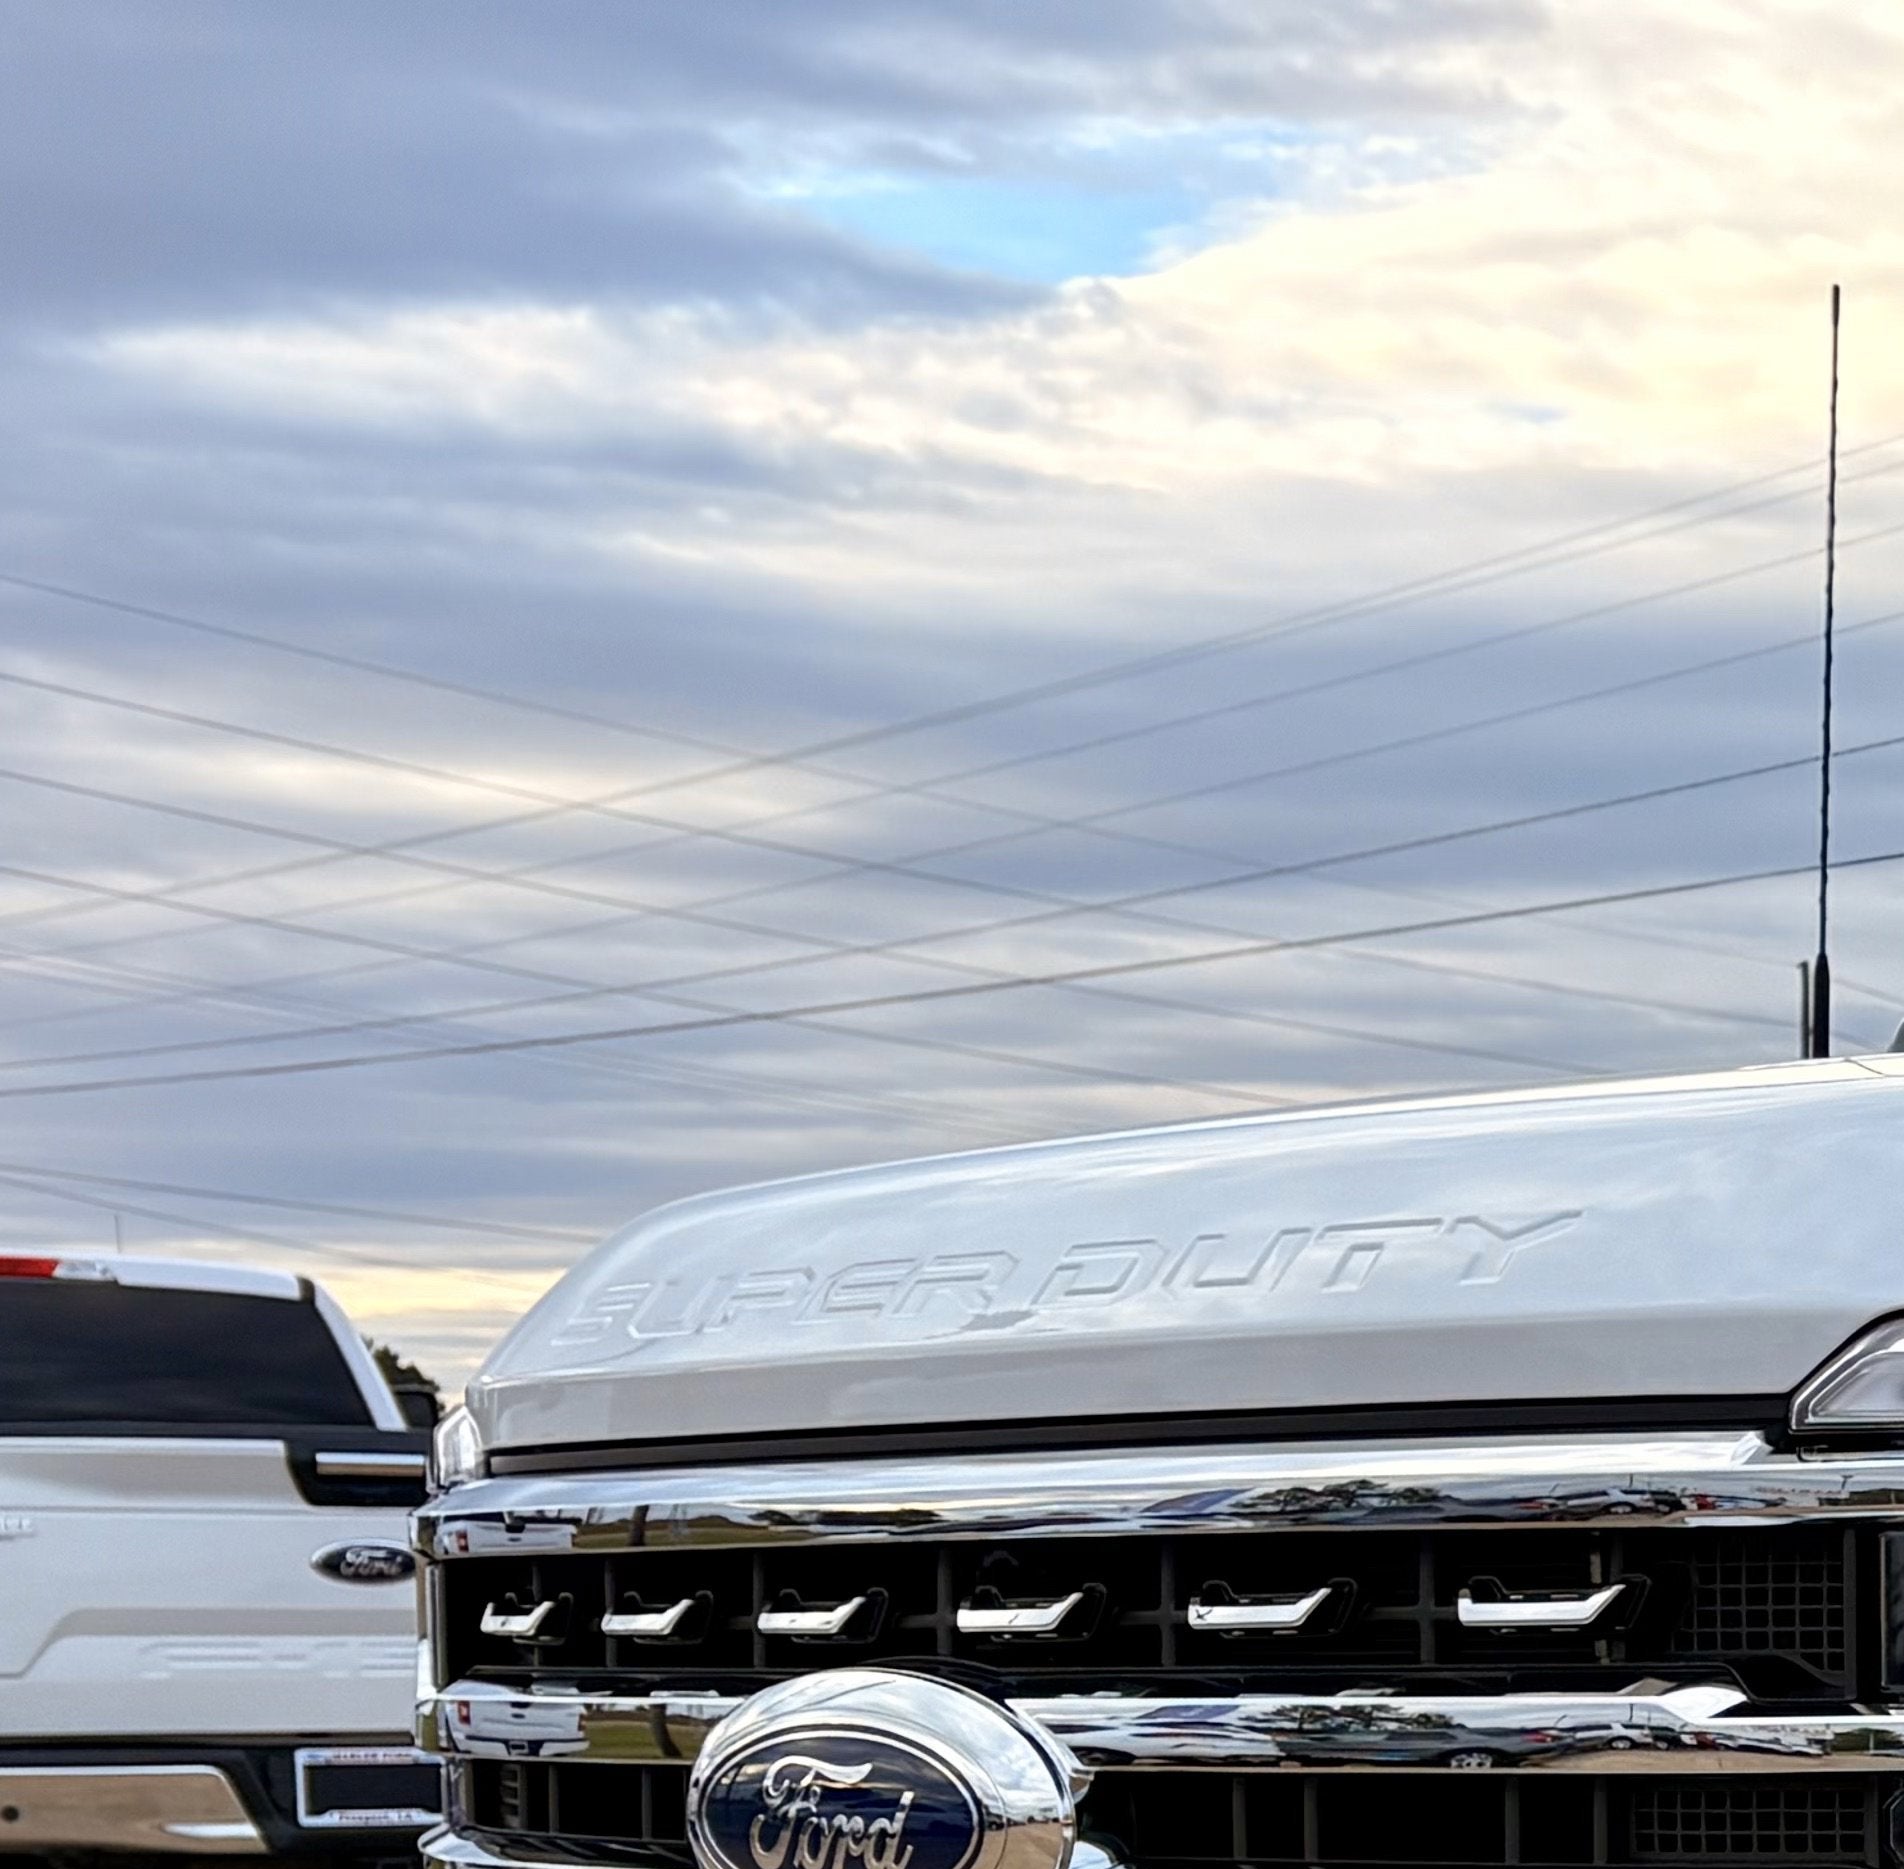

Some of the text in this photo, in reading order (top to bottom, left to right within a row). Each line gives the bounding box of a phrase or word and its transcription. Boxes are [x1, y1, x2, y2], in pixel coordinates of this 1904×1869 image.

[551, 1209, 1586, 1347] SUPER DUTY
[340, 1546, 403, 1577] Ford
